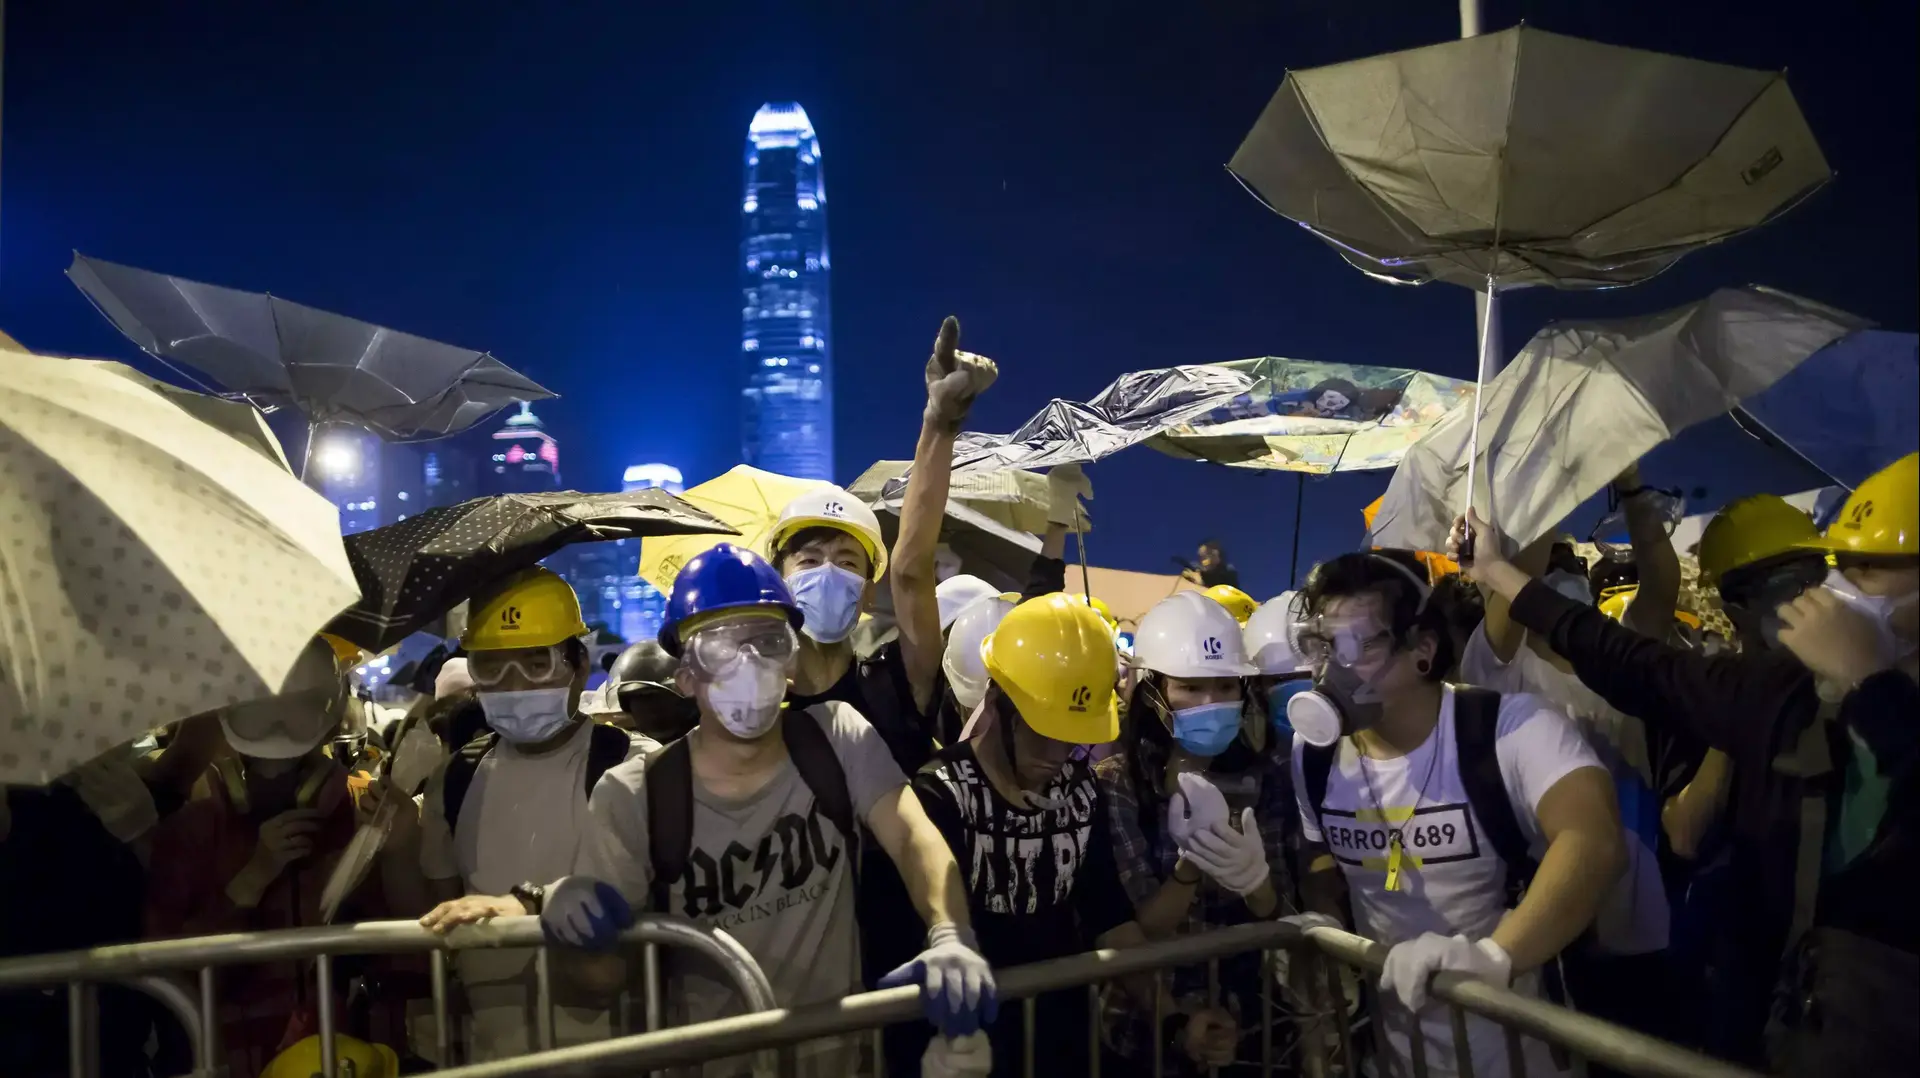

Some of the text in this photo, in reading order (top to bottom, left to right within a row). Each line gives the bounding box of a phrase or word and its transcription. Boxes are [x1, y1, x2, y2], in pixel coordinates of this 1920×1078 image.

[1330, 823, 1456, 850] ERROR 689
[749, 902, 773, 922] IN
